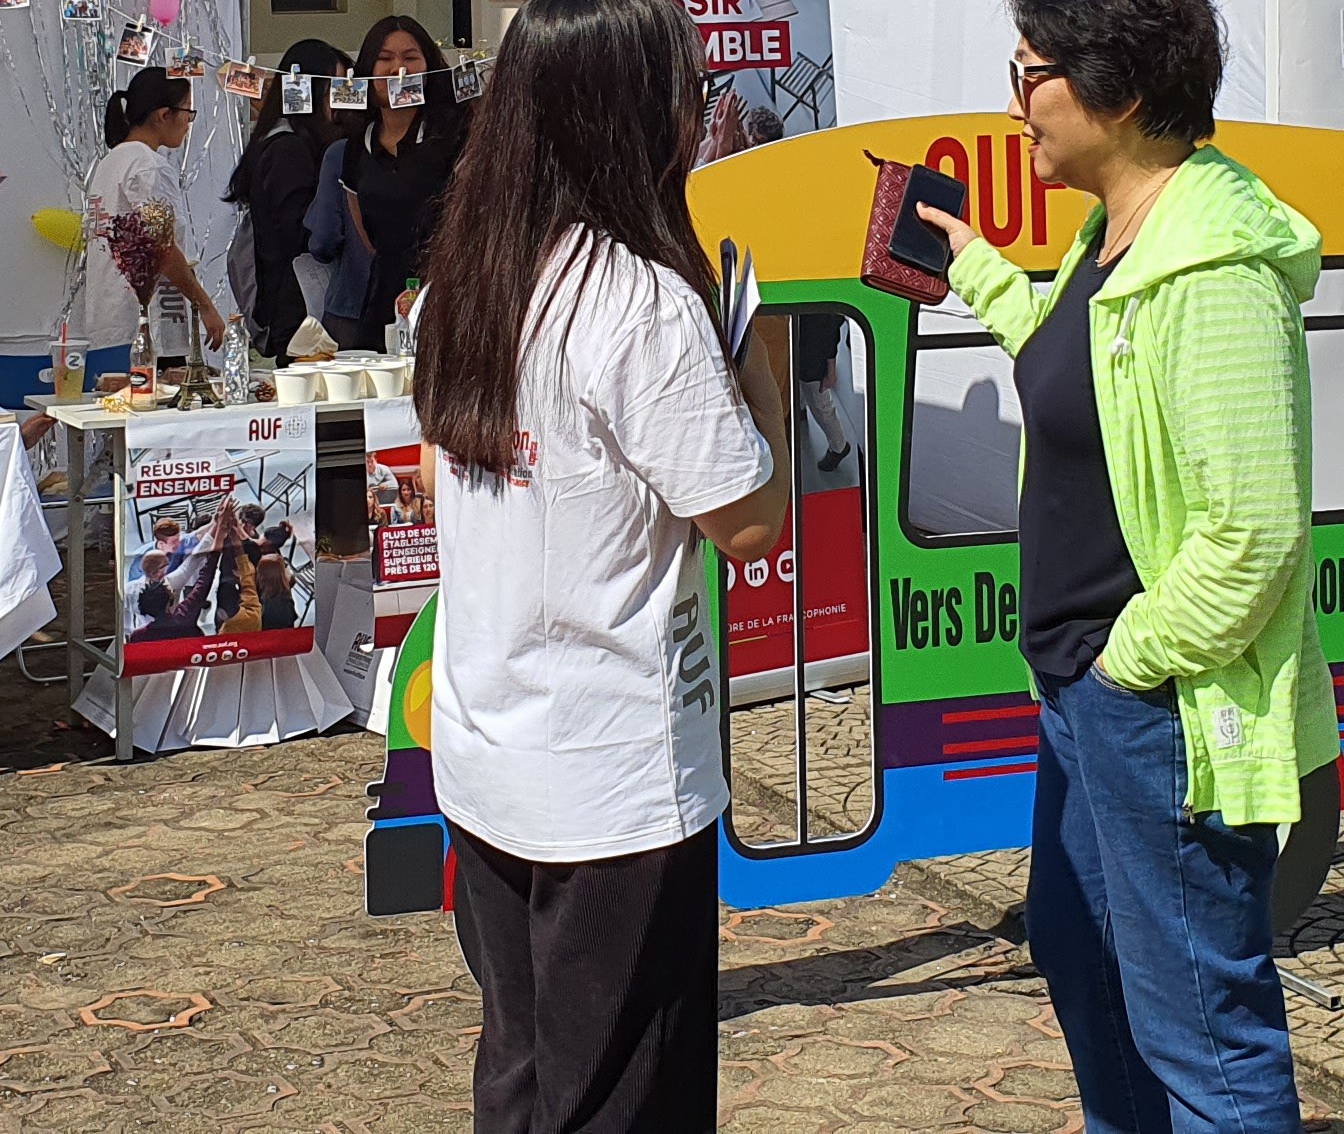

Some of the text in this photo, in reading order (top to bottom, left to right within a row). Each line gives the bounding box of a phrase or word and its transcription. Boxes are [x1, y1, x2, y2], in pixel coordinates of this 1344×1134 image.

[707, 29, 782, 62] MBLE
[249, 417, 282, 441] AUF
[141, 460, 211, 478] RÉUSSIR
[140, 477, 231, 496] ENSEMBLE
[382, 528, 436, 539] PLUS DE 100
[383, 546, 436, 558] D'ENSEIGNE
[384, 554, 432, 566] SUPÉRIEUR
[410, 565, 421, 573] DE
[423, 563, 436, 571] 120
[747, 618, 760, 628] DE
[762, 614, 774, 626] LA
[890, 577, 962, 650] Vers
[673, 592, 714, 715] AUF
